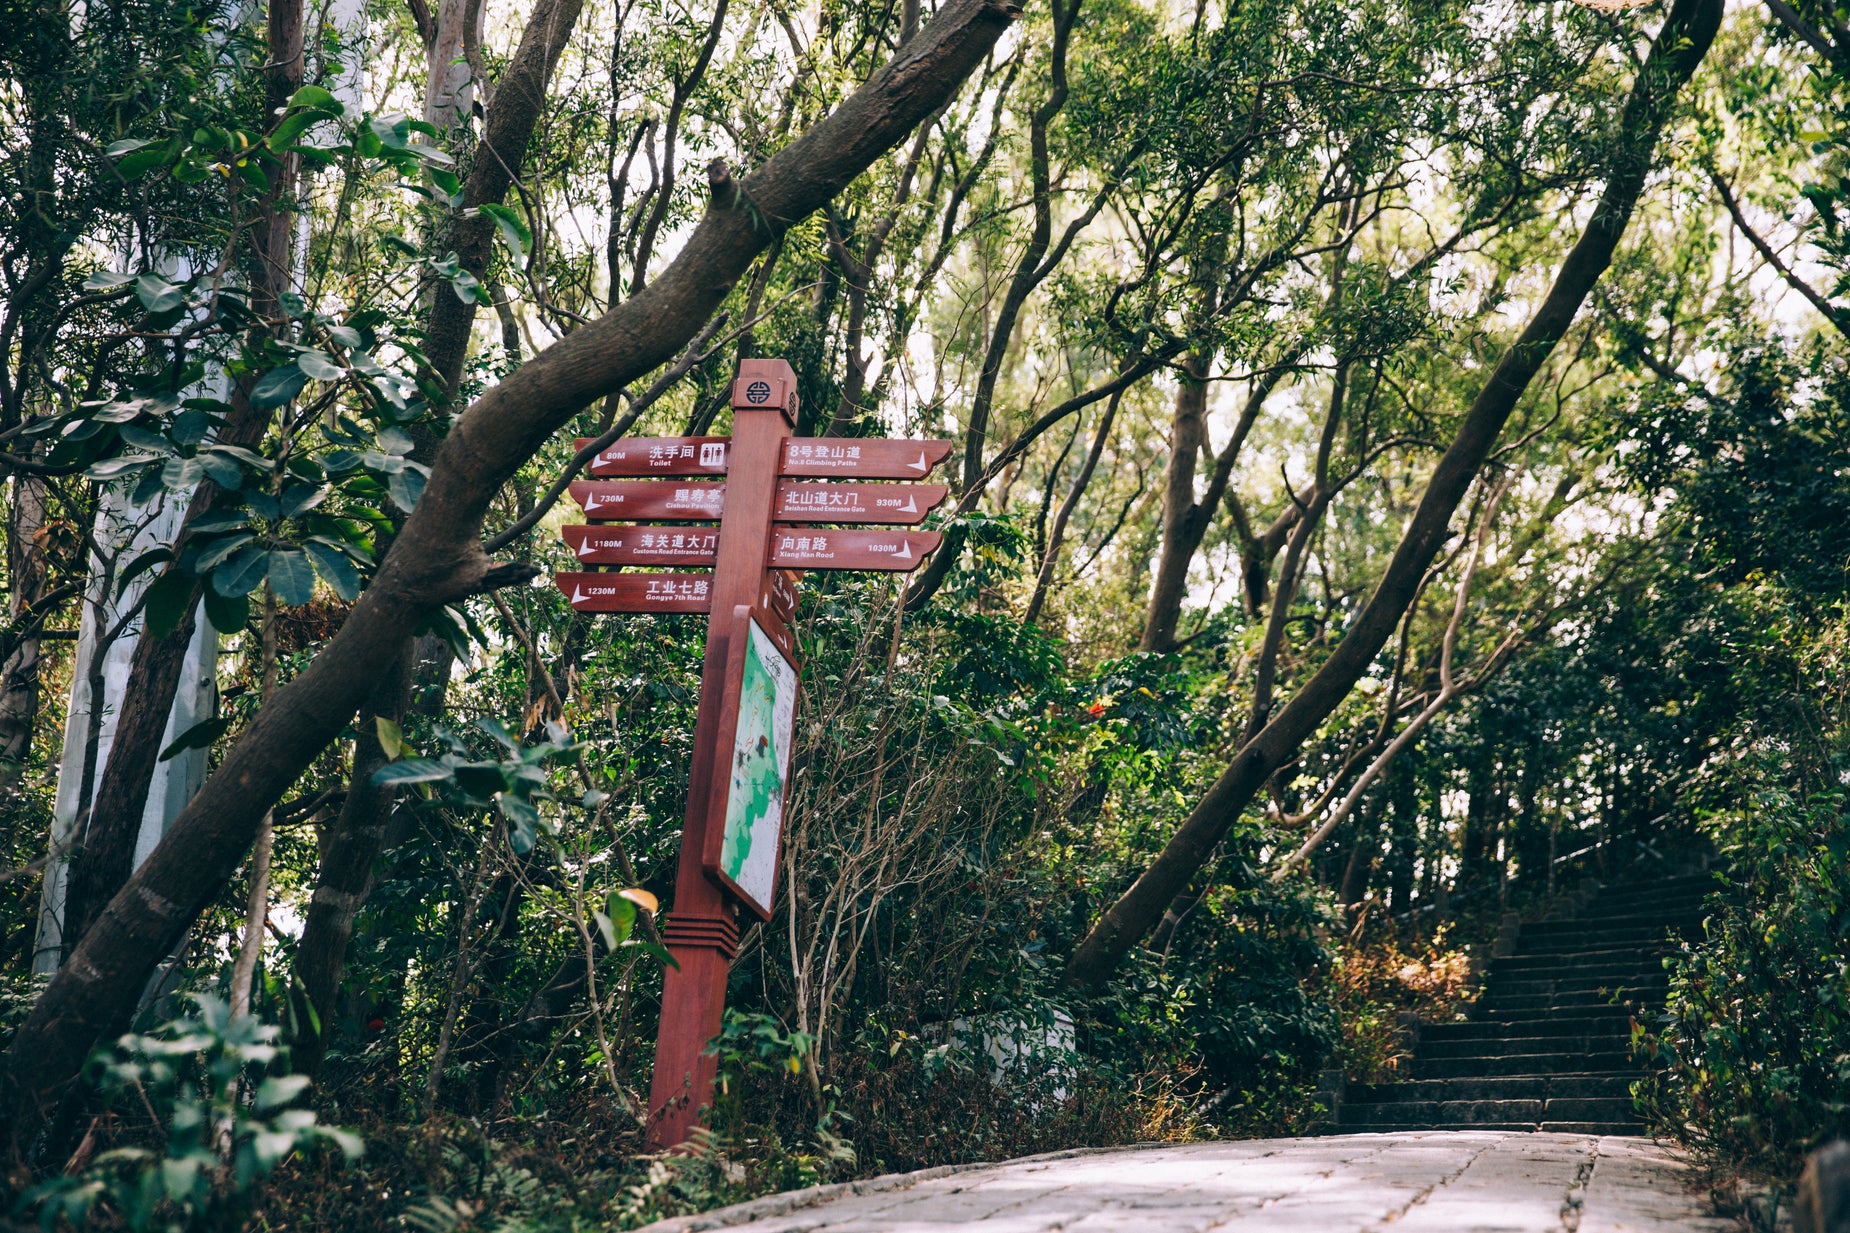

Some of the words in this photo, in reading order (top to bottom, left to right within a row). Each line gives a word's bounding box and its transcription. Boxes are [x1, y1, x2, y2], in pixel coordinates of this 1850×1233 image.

[607, 452, 626, 460] 80M
[649, 445, 695, 459] 洗手间
[790, 445, 861, 459] 8号登山道
[805, 459, 837, 467] Climbing
[600, 495, 624, 503] 730M
[675, 489, 721, 503] 赐寿亭
[785, 491, 858, 505] 北山道大门
[876, 499, 902, 507] 930M
[594, 540, 622, 548] 1180M
[641, 534, 716, 548] 海关道大门
[780, 536, 828, 551] 向南路
[868, 544, 897, 552] 1030M
[588, 587, 616, 595] 1230M
[646, 580, 709, 594] 工业七路
